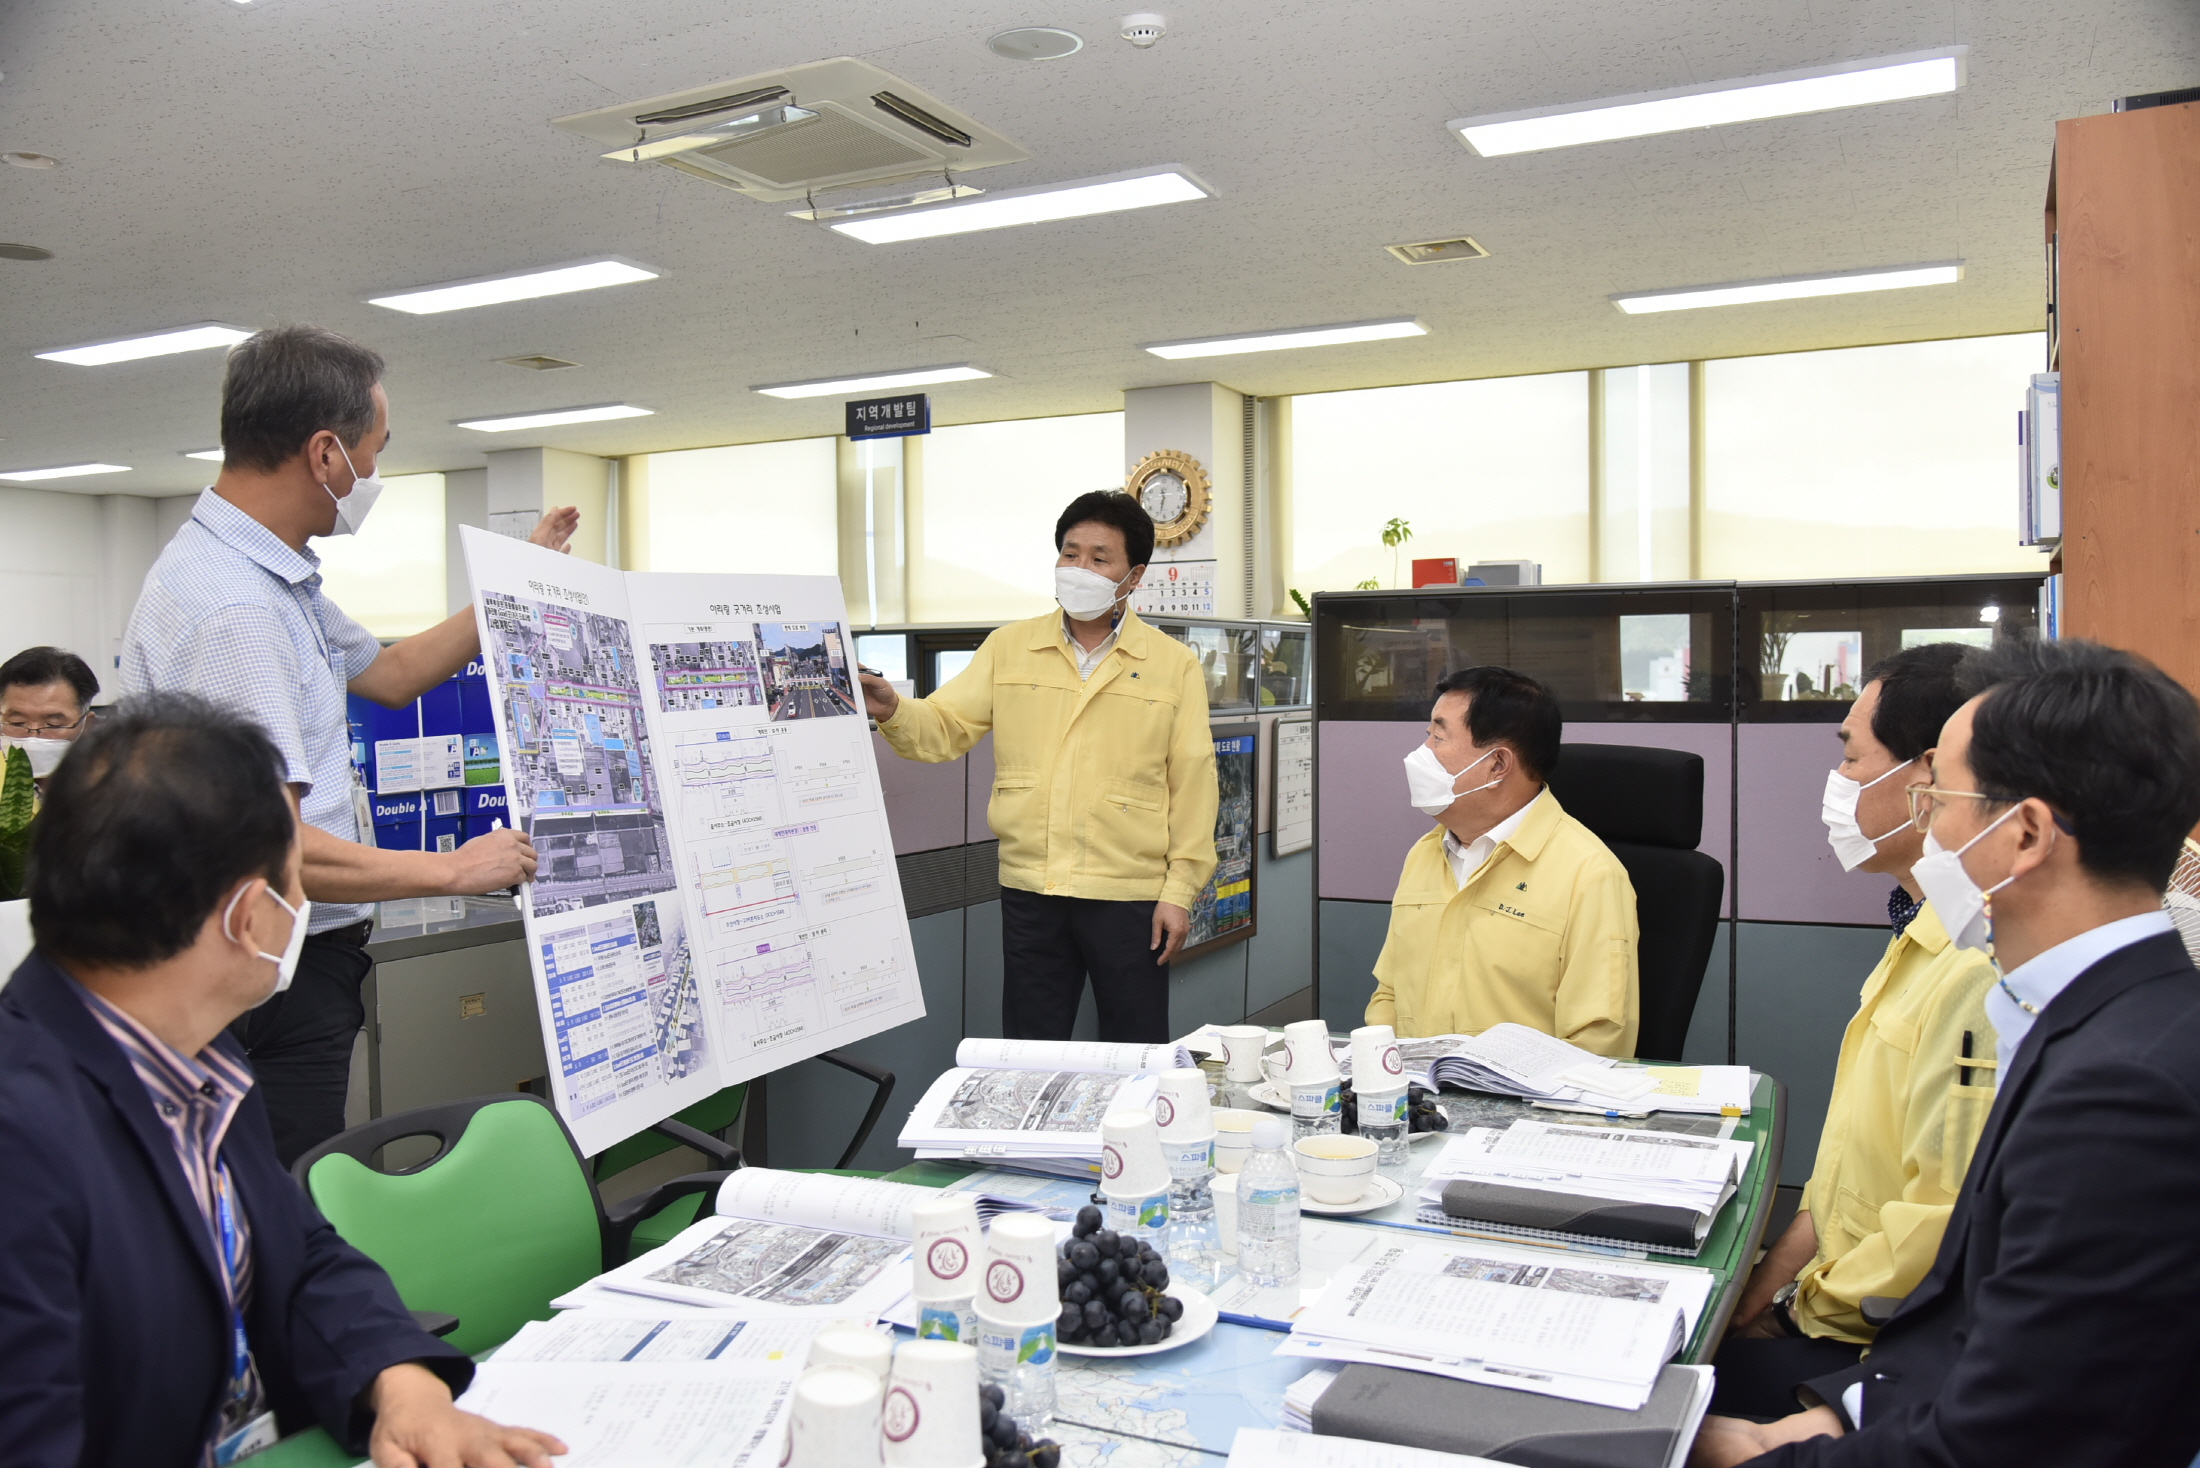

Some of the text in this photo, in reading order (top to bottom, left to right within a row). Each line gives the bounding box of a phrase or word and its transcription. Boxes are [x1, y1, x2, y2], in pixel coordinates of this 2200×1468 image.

[856, 401, 916, 421] 지역개발팀
[864, 421, 915, 432] Regional development
[1168, 567, 1178, 582] 9
[1193, 588, 1198, 596] 4
[733, 604, 753, 615] 굿거리
[756, 604, 782, 616] 조성사업
[1160, 604, 1165, 612] 8
[376, 801, 415, 817] Double
[1298, 1094, 1322, 1104] 스파클
[1367, 1103, 1392, 1113] 스파클
[1180, 1151, 1207, 1163] 스파클
[1110, 1201, 1137, 1216] 스파클
[982, 1334, 1016, 1350] 스파클
